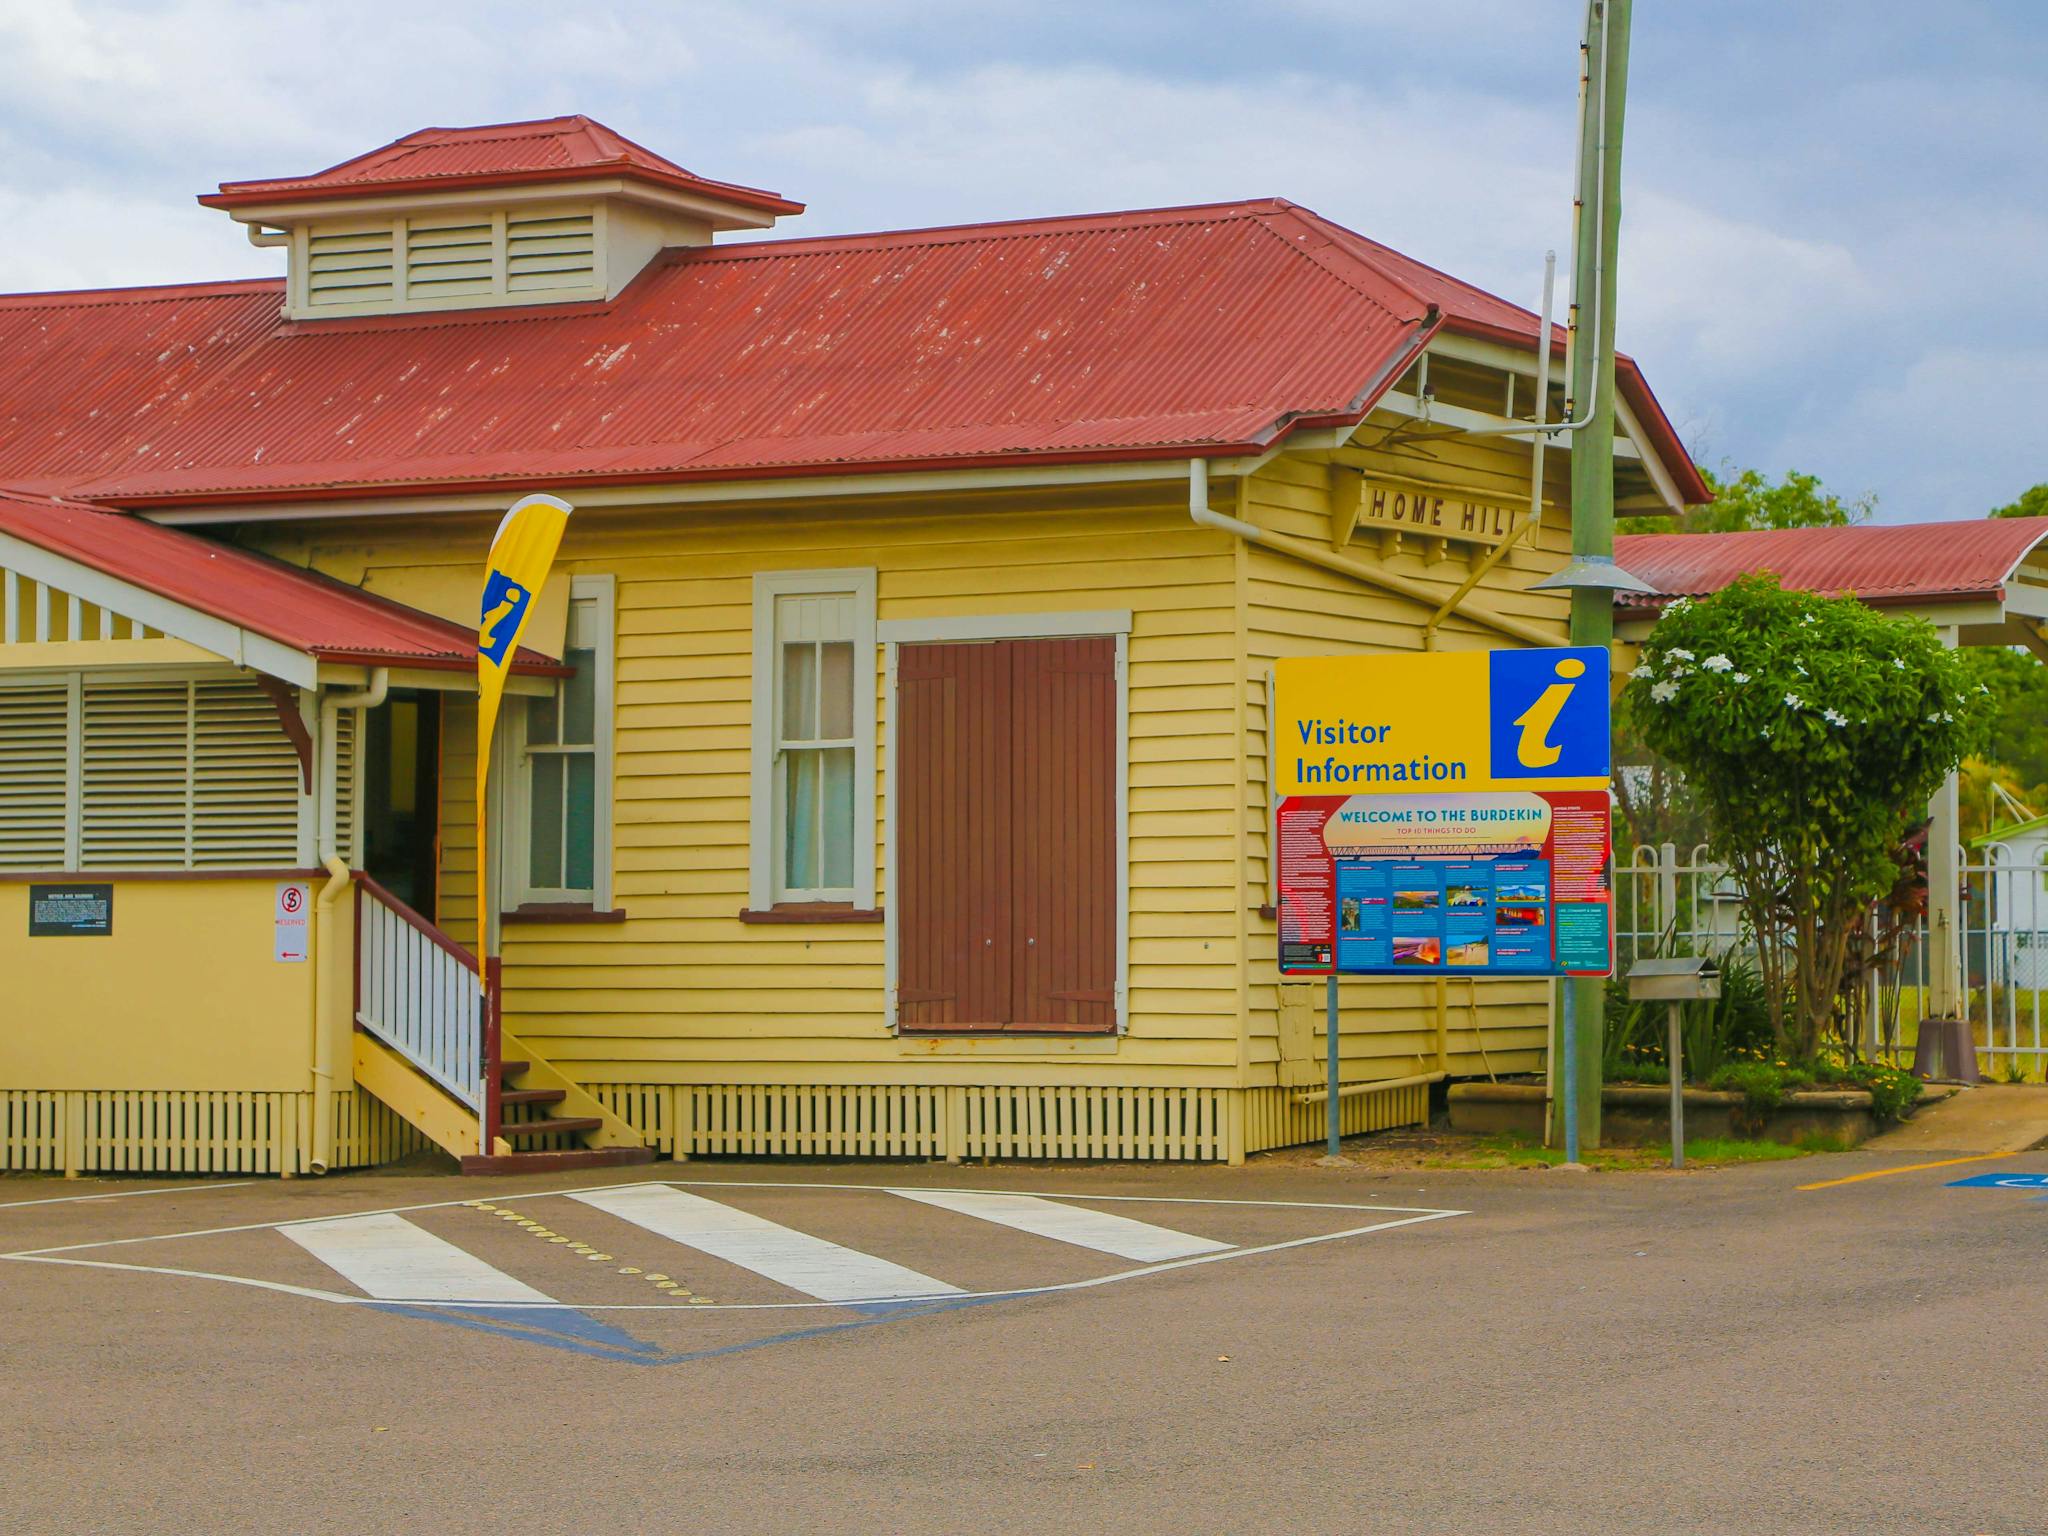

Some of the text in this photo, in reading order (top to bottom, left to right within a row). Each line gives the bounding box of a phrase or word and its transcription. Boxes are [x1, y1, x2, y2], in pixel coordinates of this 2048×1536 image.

[1369, 489, 1444, 526] HOME
[1512, 658, 1586, 768] i
[1297, 719, 1391, 745] Visitor
[1297, 755, 1466, 783] Information
[1340, 809, 1542, 823] WELCOME TO THE BURDEKIN
